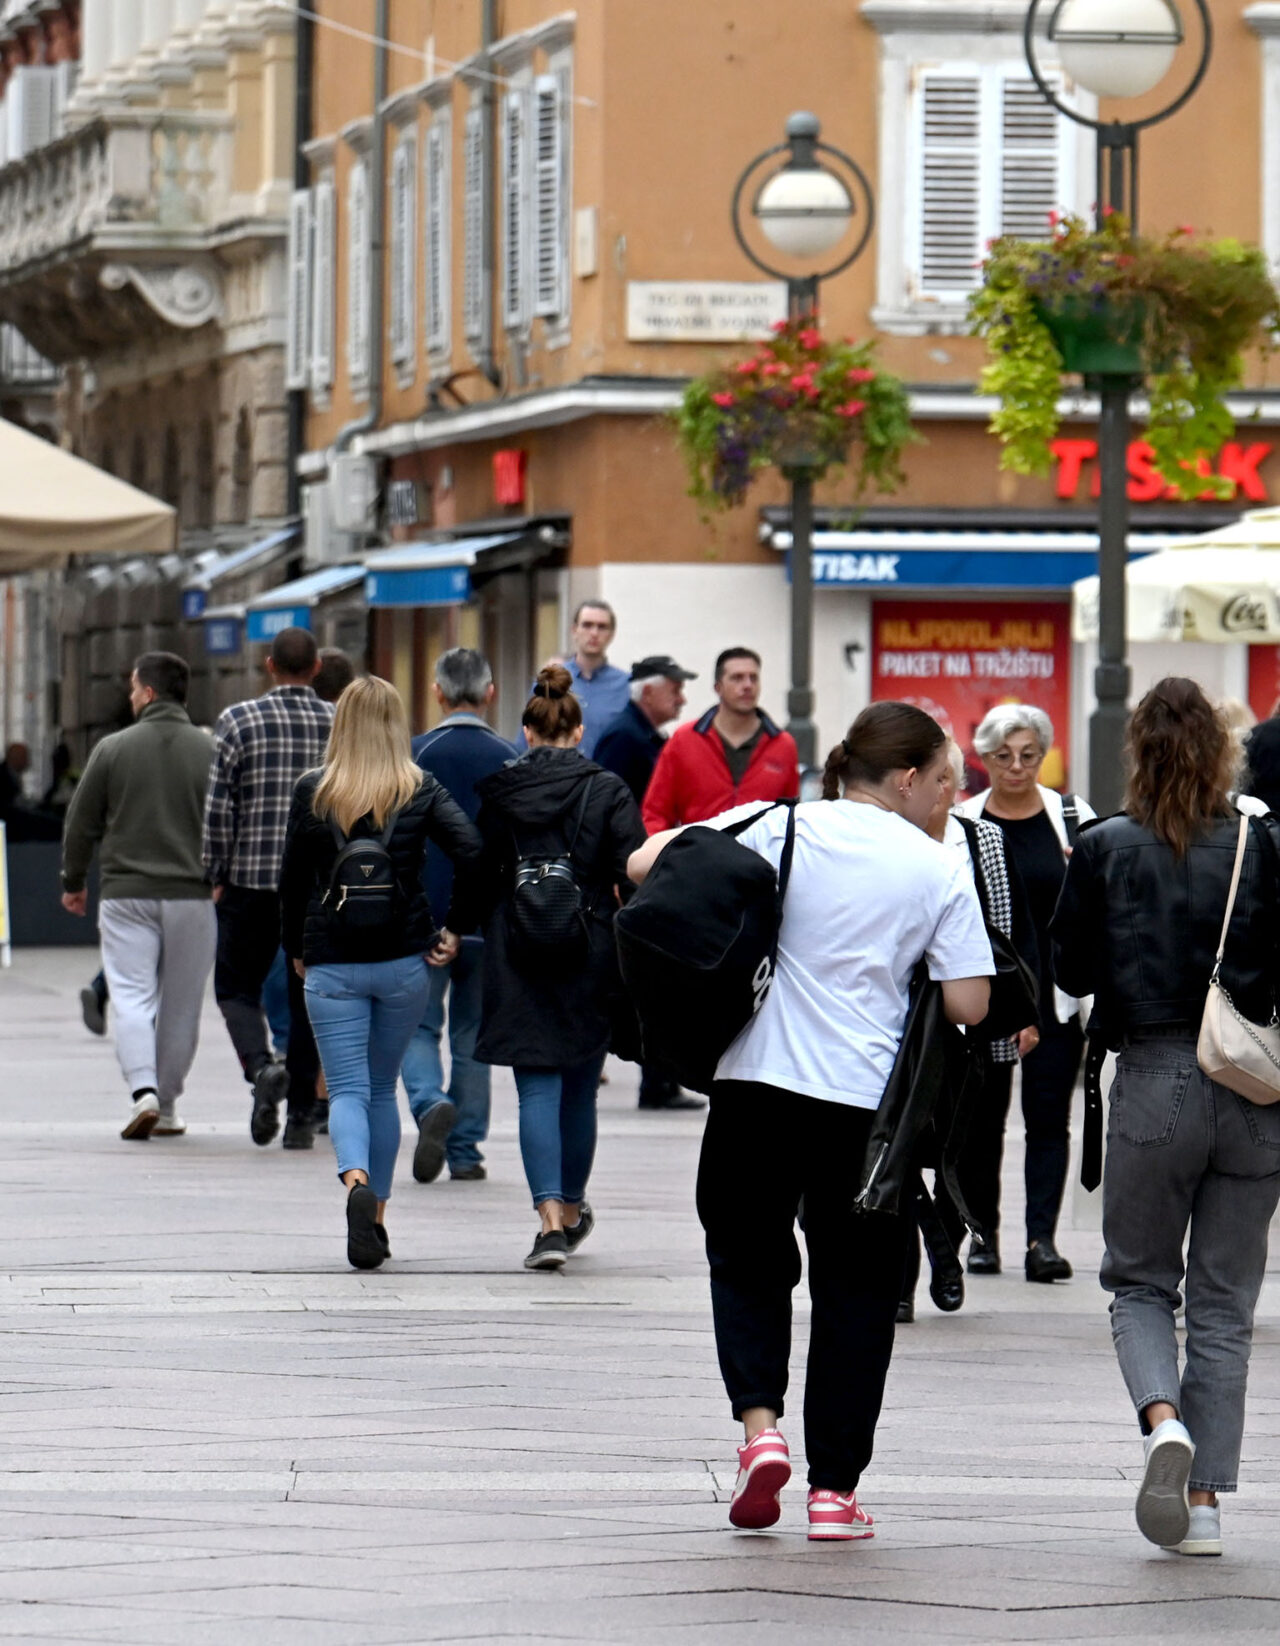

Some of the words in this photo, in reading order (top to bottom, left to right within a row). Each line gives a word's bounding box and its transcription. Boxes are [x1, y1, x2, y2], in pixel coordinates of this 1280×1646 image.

[1050, 440, 1271, 500] TSK
[811, 553, 900, 581] TISAK
[880, 652, 942, 678] PAKET
[944, 653, 971, 677] NA
[974, 647, 1055, 678] TRŽIŠTU
